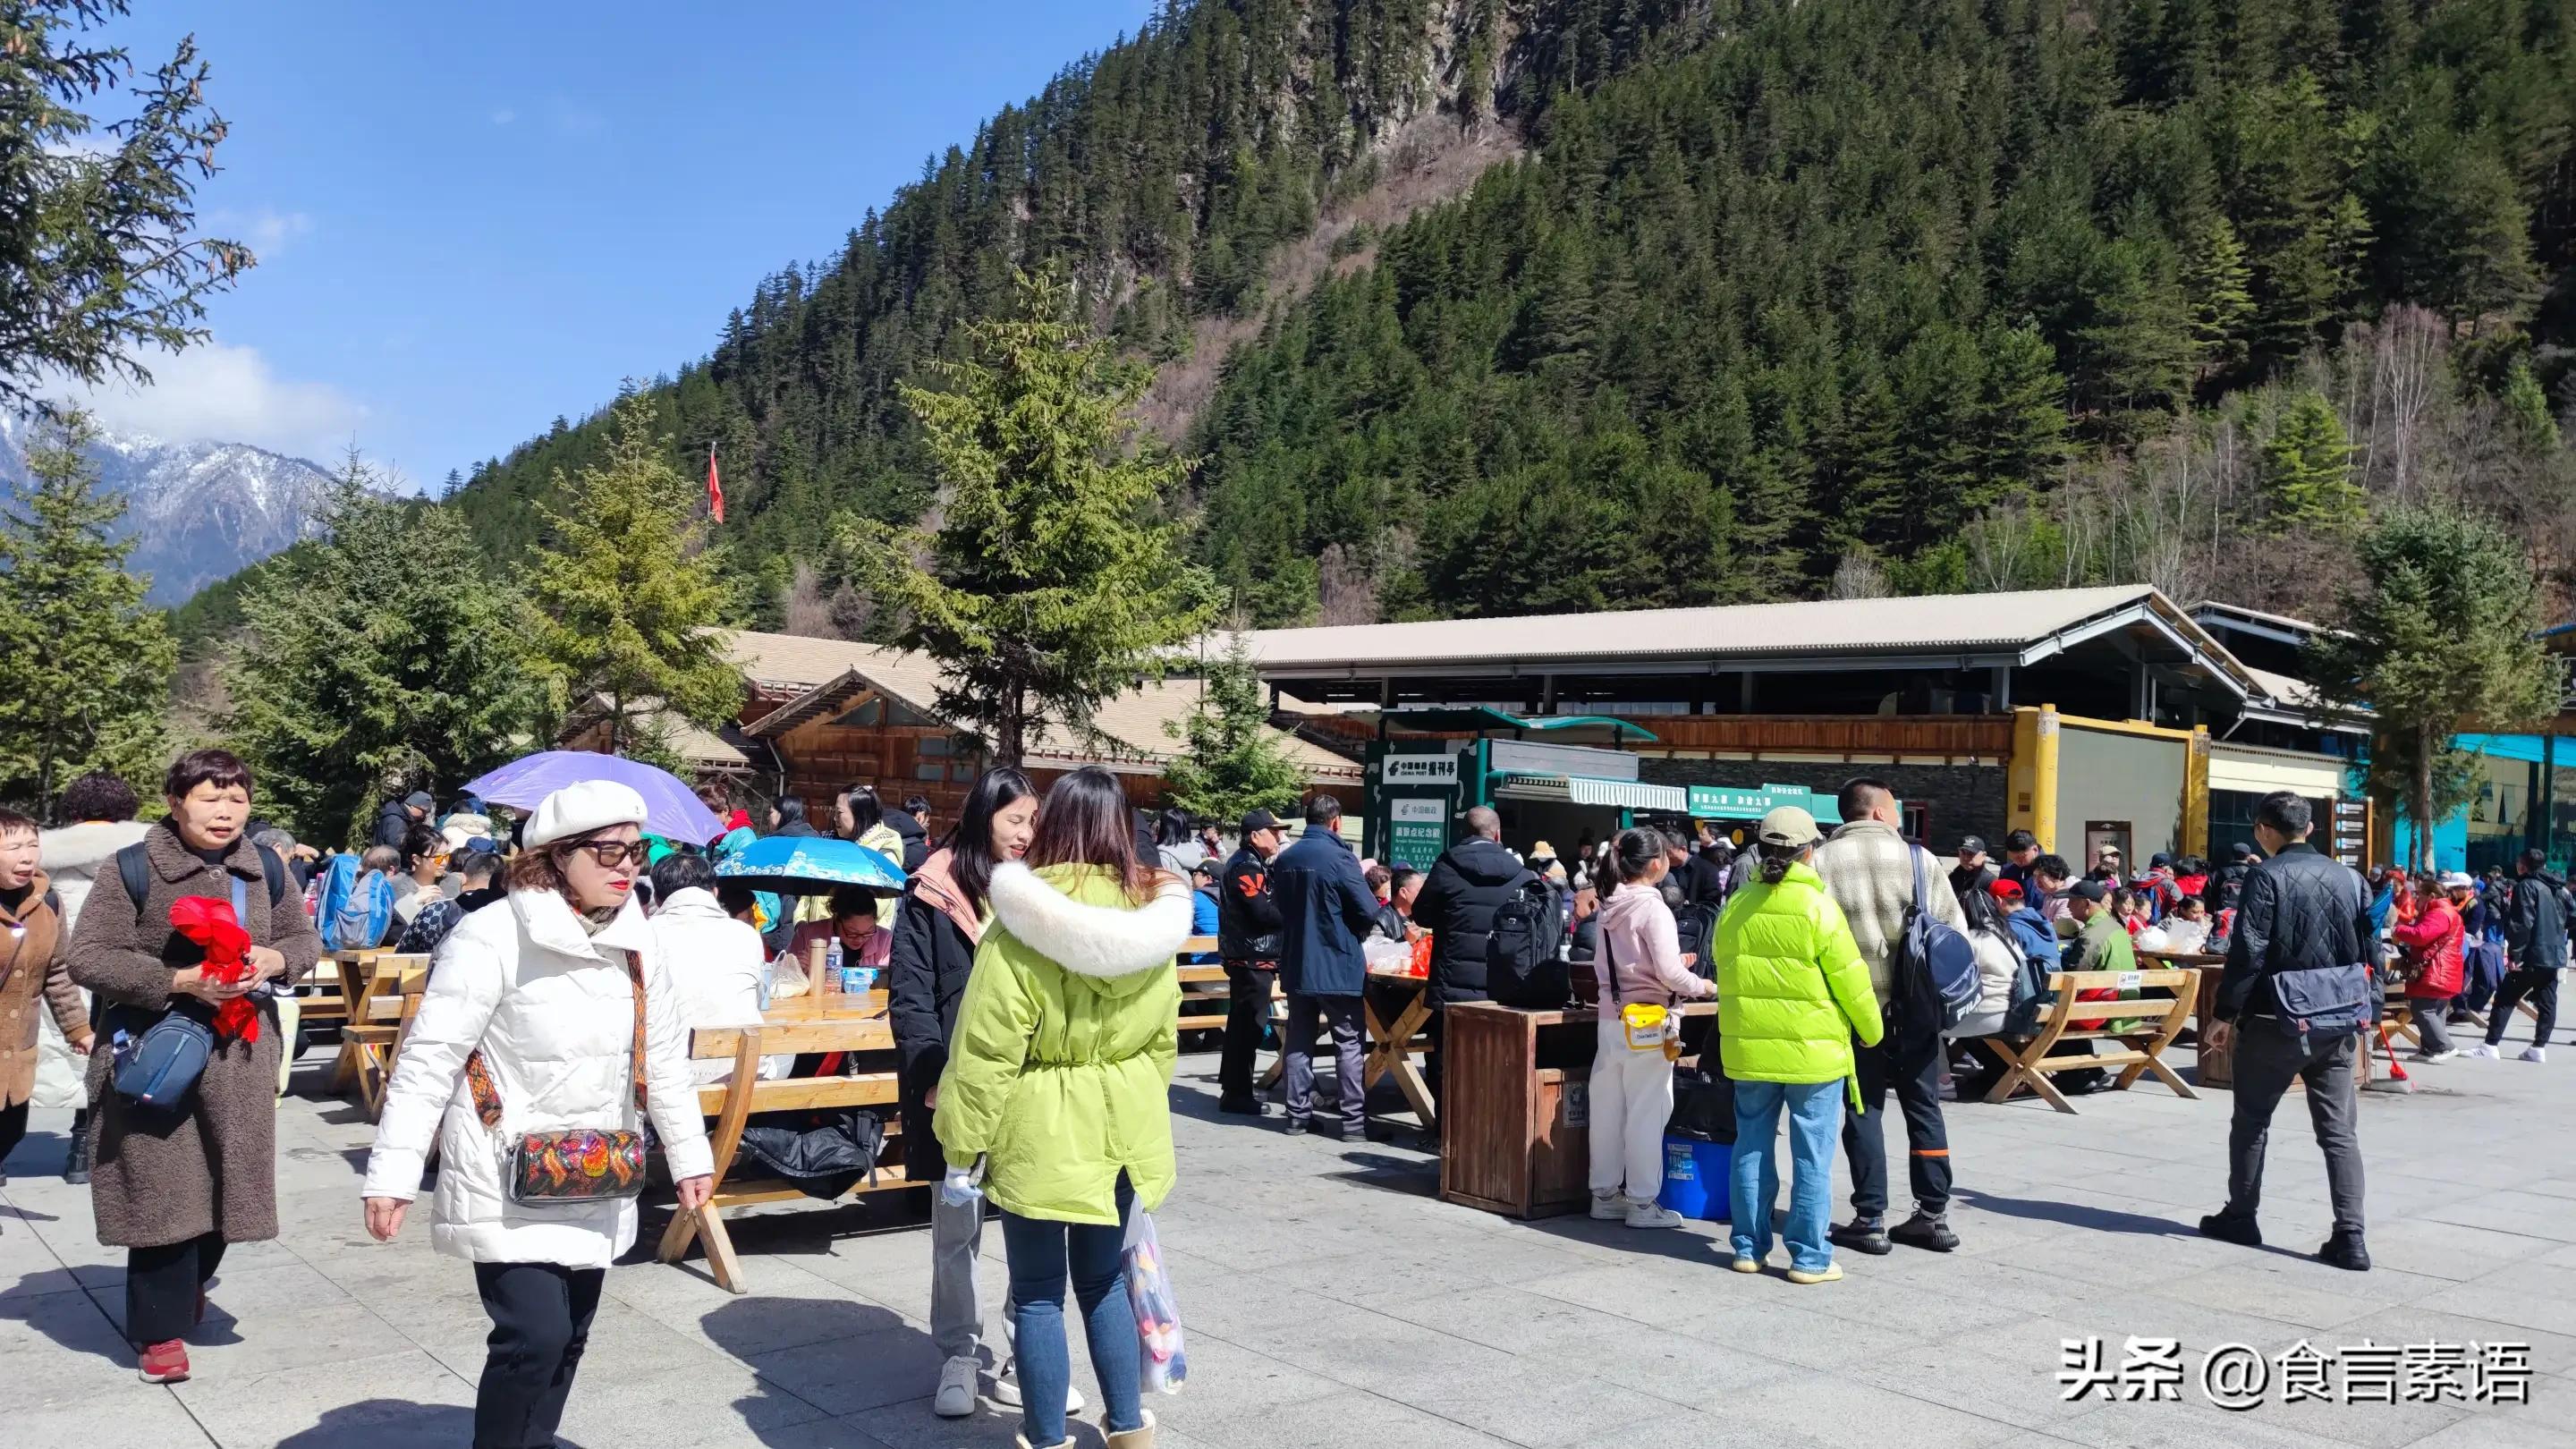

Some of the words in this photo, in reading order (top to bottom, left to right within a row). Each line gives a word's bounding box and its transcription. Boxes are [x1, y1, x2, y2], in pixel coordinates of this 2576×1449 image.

[1401, 762, 1427, 770] 中国邮政
[1428, 761, 1455, 776] 报刊亭
[1411, 805, 1437, 815] 中国邮政
[1956, 993, 1982, 1022] FILA
